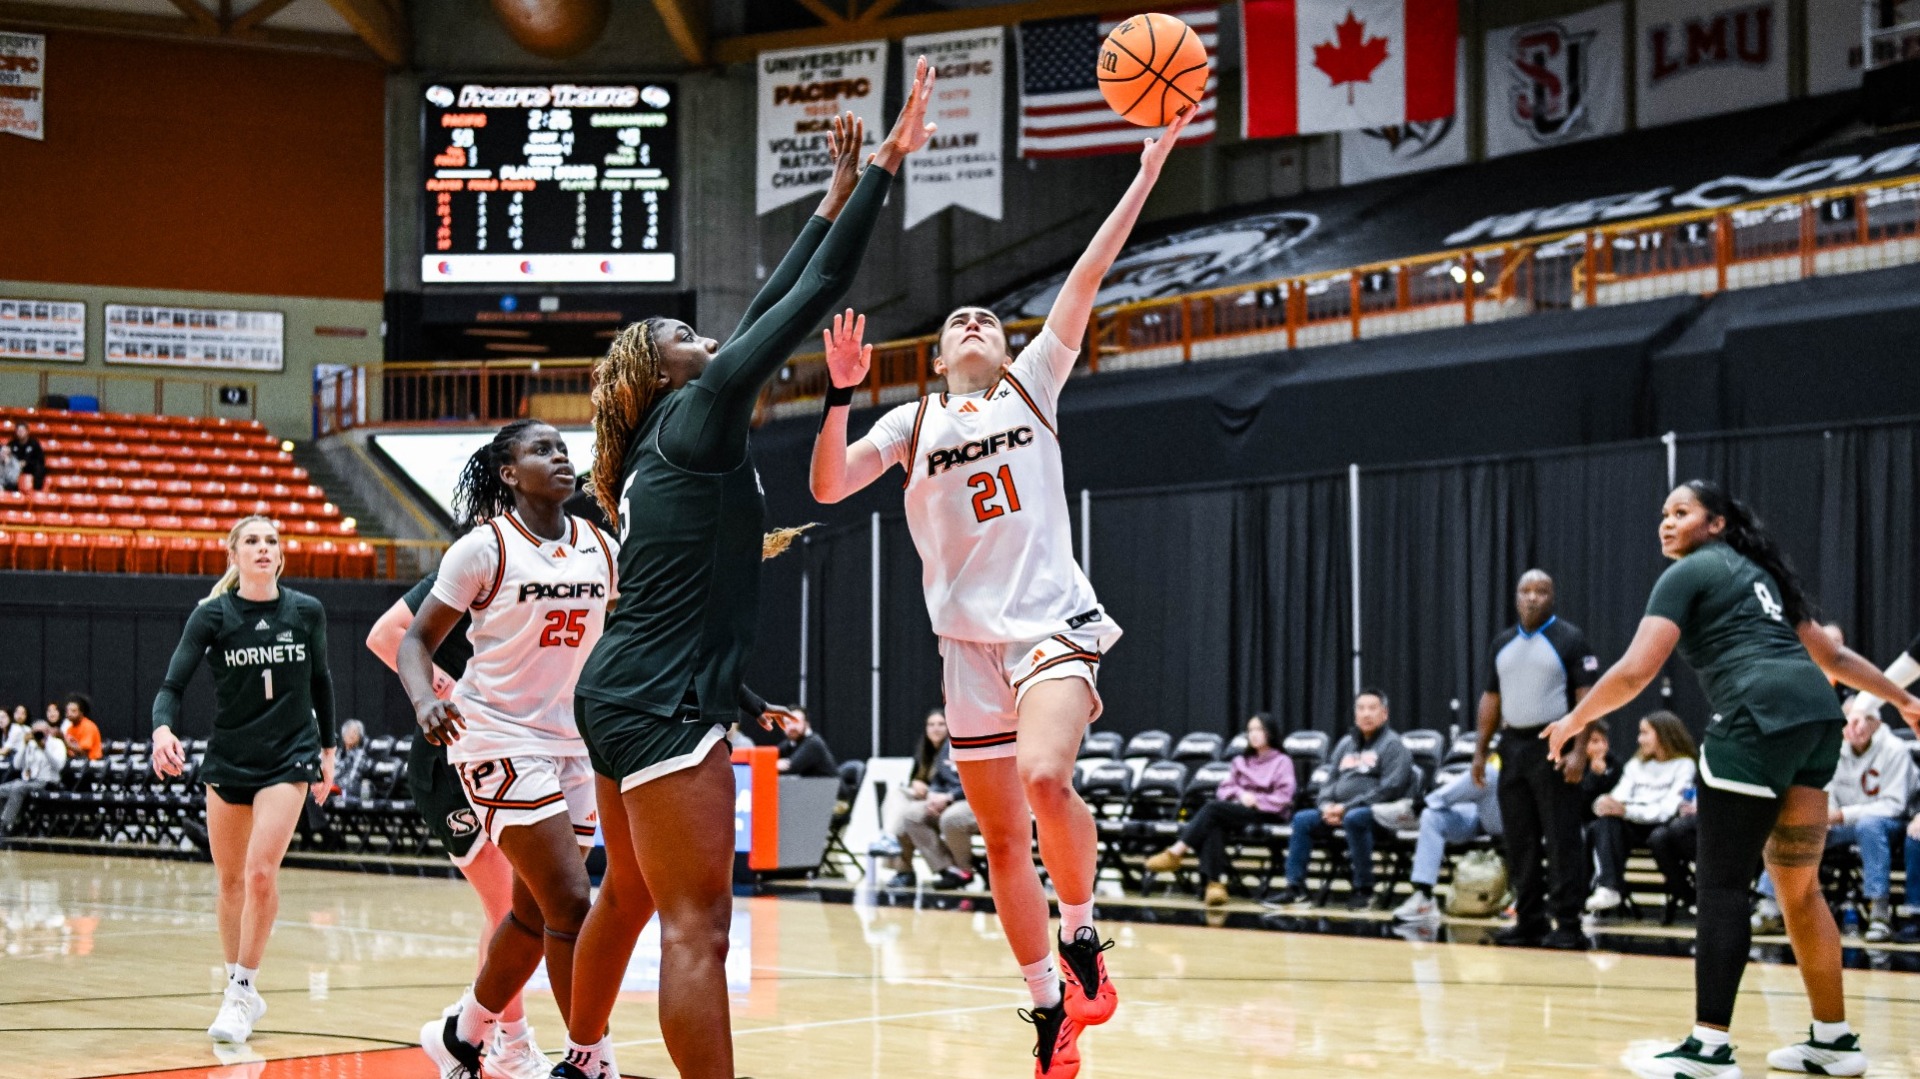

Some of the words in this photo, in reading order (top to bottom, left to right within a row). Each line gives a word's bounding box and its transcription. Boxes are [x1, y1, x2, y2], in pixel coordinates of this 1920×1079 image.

[905, 37, 999, 57] UNIVERSITY
[1650, 7, 1775, 88] LMU
[763, 48, 878, 74] UNIVERSITY
[926, 60, 993, 79] ACIFIC
[773, 77, 871, 107] PACIFIC
[928, 133, 978, 151] AIAW
[911, 152, 996, 169] VOLLEYBALL
[926, 425, 1035, 478] PACIFIC
[967, 463, 1022, 523] 21
[517, 582, 606, 605] PACIFIC
[539, 608, 590, 648] 25
[224, 643, 307, 668] HORNETS
[261, 668, 274, 700] 1
[1861, 768, 1882, 796] C
